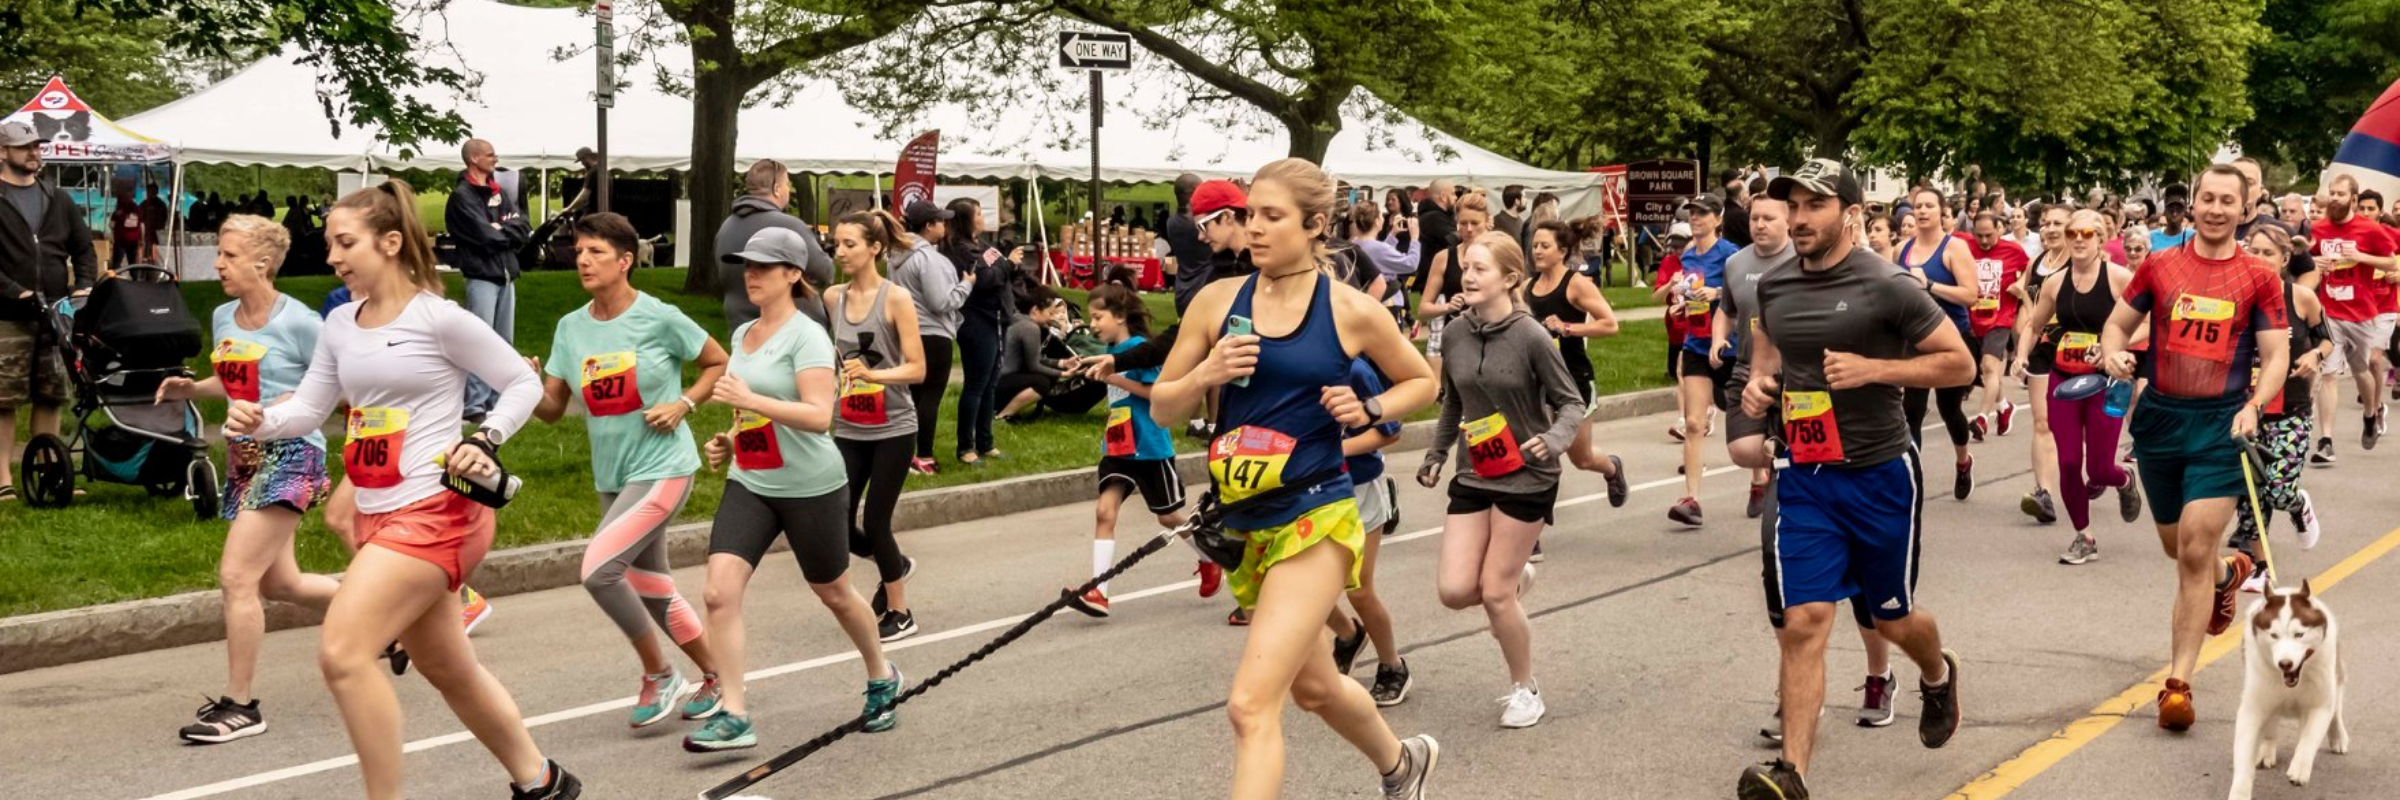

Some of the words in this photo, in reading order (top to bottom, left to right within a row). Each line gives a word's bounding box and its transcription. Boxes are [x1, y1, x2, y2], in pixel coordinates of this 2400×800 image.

[1076, 42, 1097, 57] ONE
[1102, 43, 1124, 58] WAY
[55, 144, 92, 157] PET
[1629, 170, 1659, 180] BROWN
[1661, 170, 1694, 180] SQUARE
[1649, 182, 1674, 191] PARK
[1635, 212, 1674, 221] Roches
[1645, 202, 1664, 213] City
[2179, 318, 2221, 344] 715
[217, 360, 248, 386] 464
[590, 375, 625, 400] 527
[1786, 419, 1827, 445] 758
[353, 438, 388, 467] 706
[1222, 457, 1269, 489] 147
